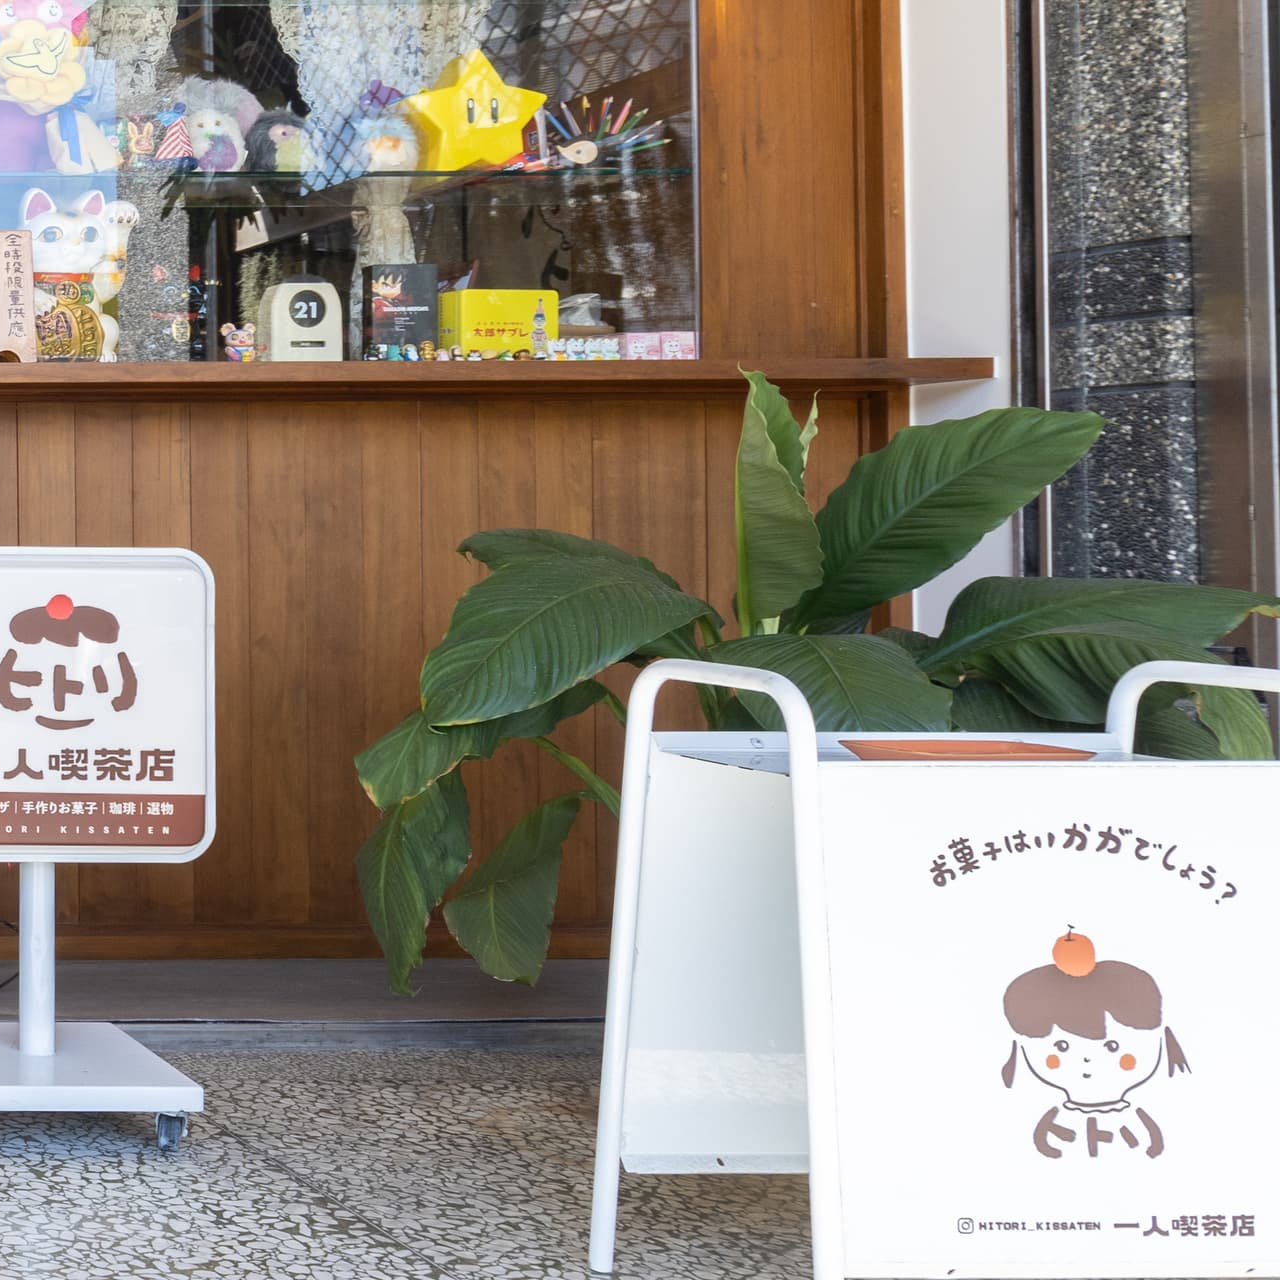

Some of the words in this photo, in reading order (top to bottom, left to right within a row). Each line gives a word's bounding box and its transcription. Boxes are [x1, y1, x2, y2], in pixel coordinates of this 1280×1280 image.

[294, 301, 318, 319] 21
[21, 800, 98, 815] 手作りお菓子
[109, 801, 136, 816] 珈琲
[147, 801, 174, 816] 選物
[60, 825, 170, 835] KISSATEN
[1032, 1106, 1165, 1160] ヒトリ
[978, 1220, 1102, 1232] HITORI_KISSATEN
[1113, 1214, 1256, 1237] 一人喫茶店
